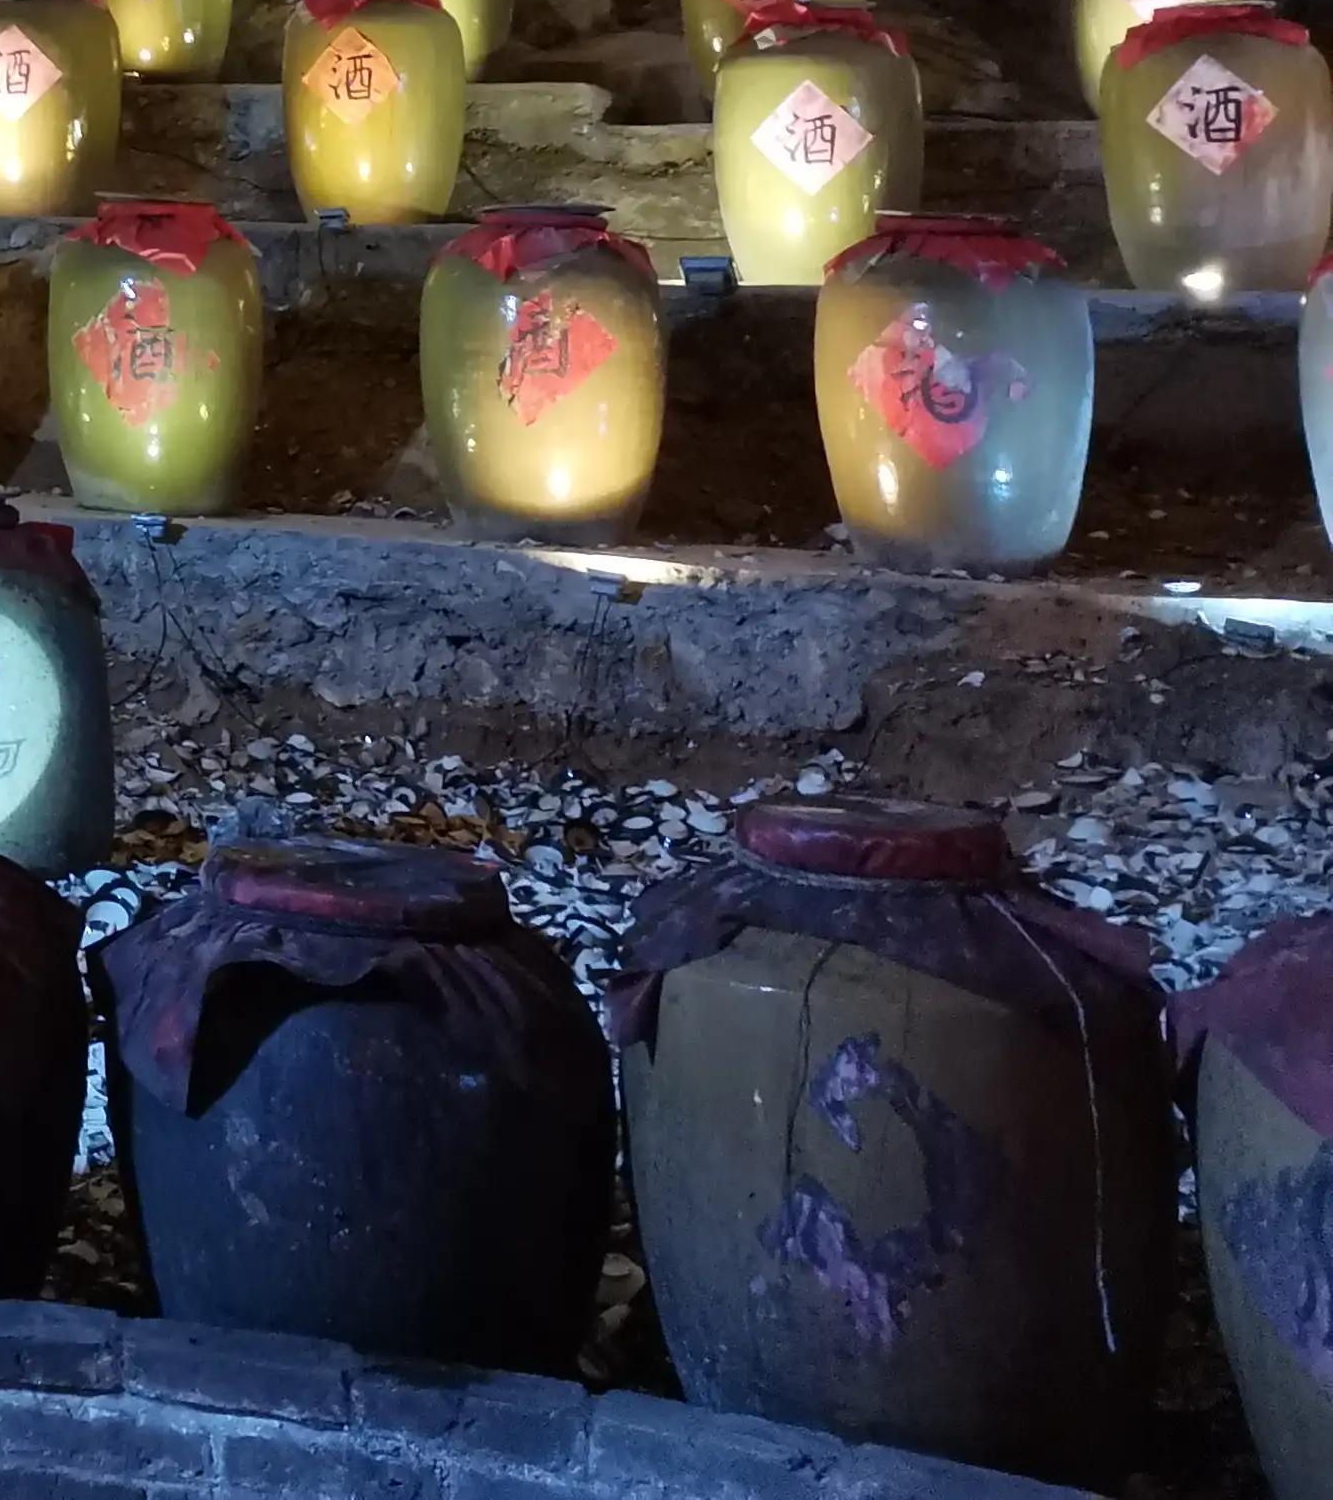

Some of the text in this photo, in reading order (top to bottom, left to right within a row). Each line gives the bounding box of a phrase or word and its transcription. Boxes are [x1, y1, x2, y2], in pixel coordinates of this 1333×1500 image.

[328, 53, 374, 100] 酒
[784, 111, 838, 166] 酒
[1182, 85, 1242, 143] 酒
